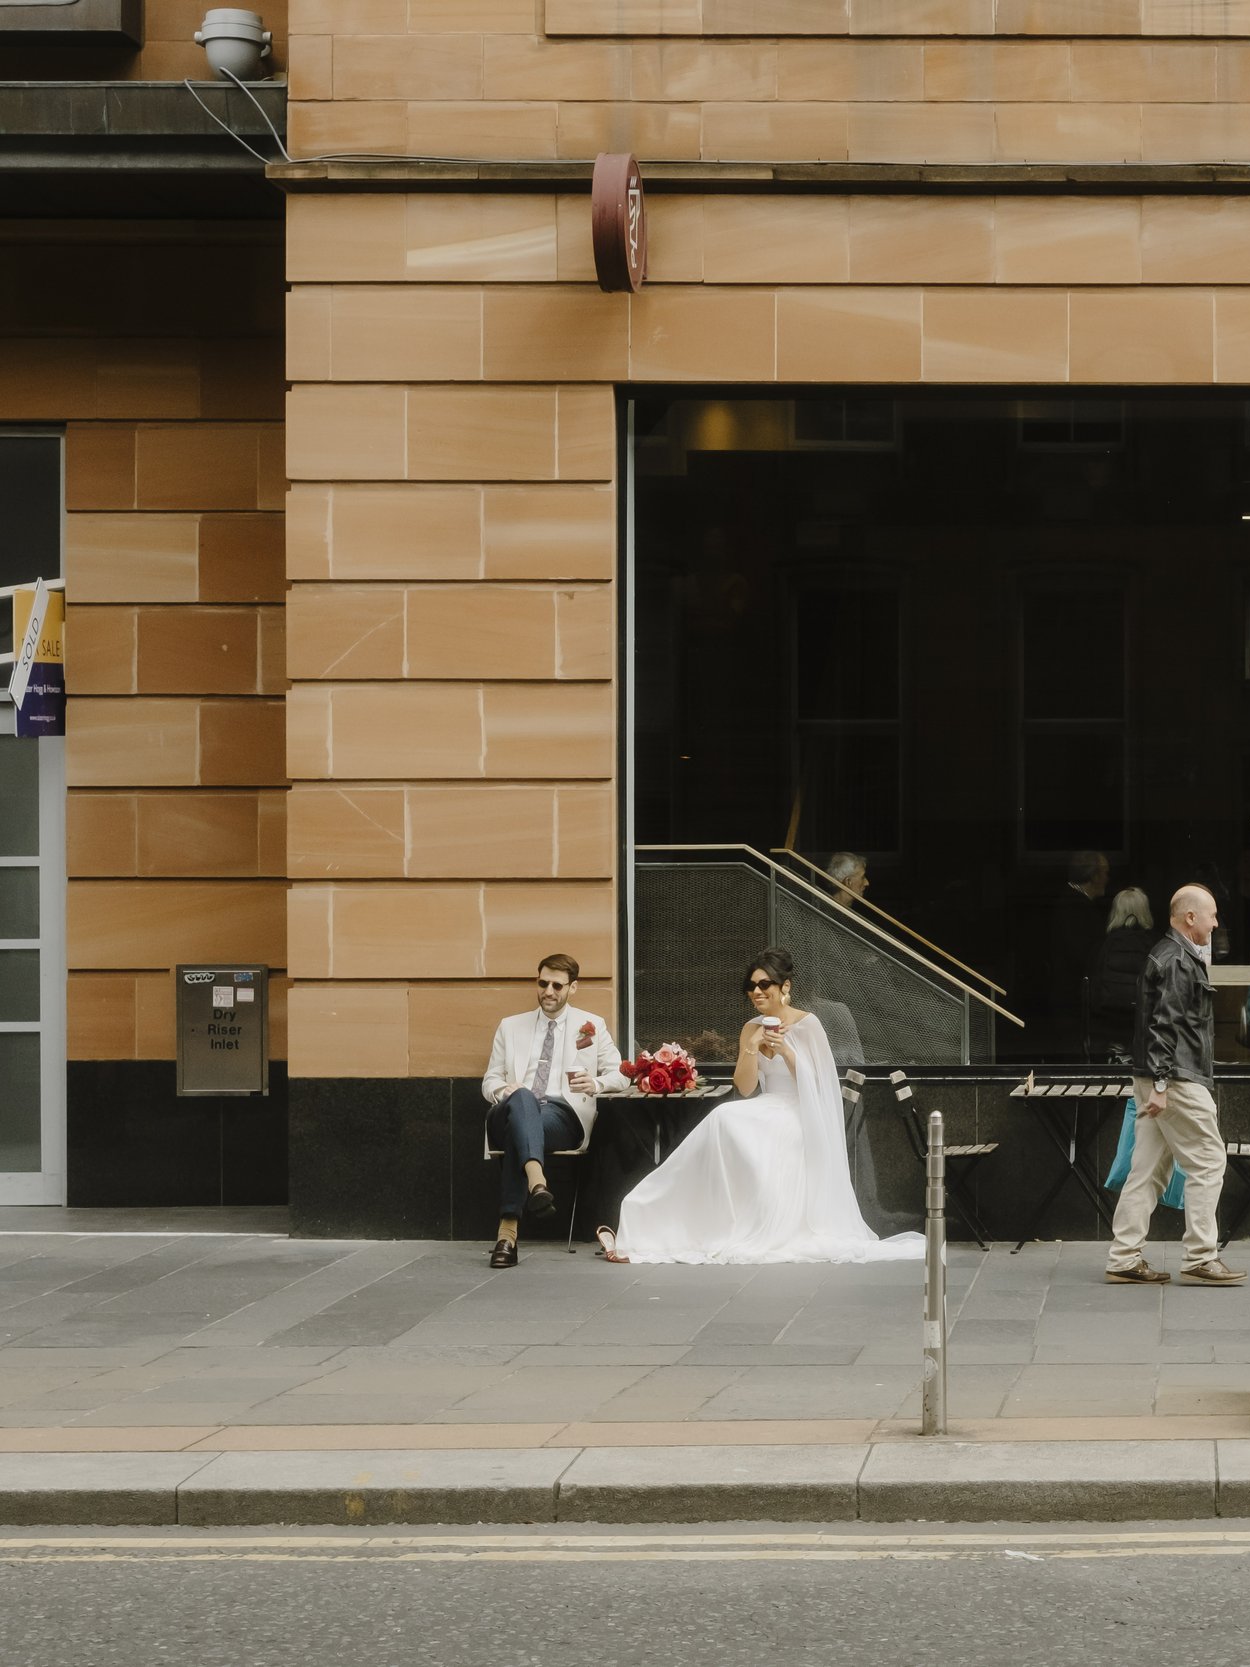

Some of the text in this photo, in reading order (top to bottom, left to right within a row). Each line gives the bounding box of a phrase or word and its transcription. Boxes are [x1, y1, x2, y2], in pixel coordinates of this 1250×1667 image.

[21, 617, 41, 671] SOLD
[42, 639, 61, 658] SALE
[213, 1008, 236, 1022] Dry
[207, 1024, 242, 1035] Riser
[210, 1039, 240, 1050] Inlet
